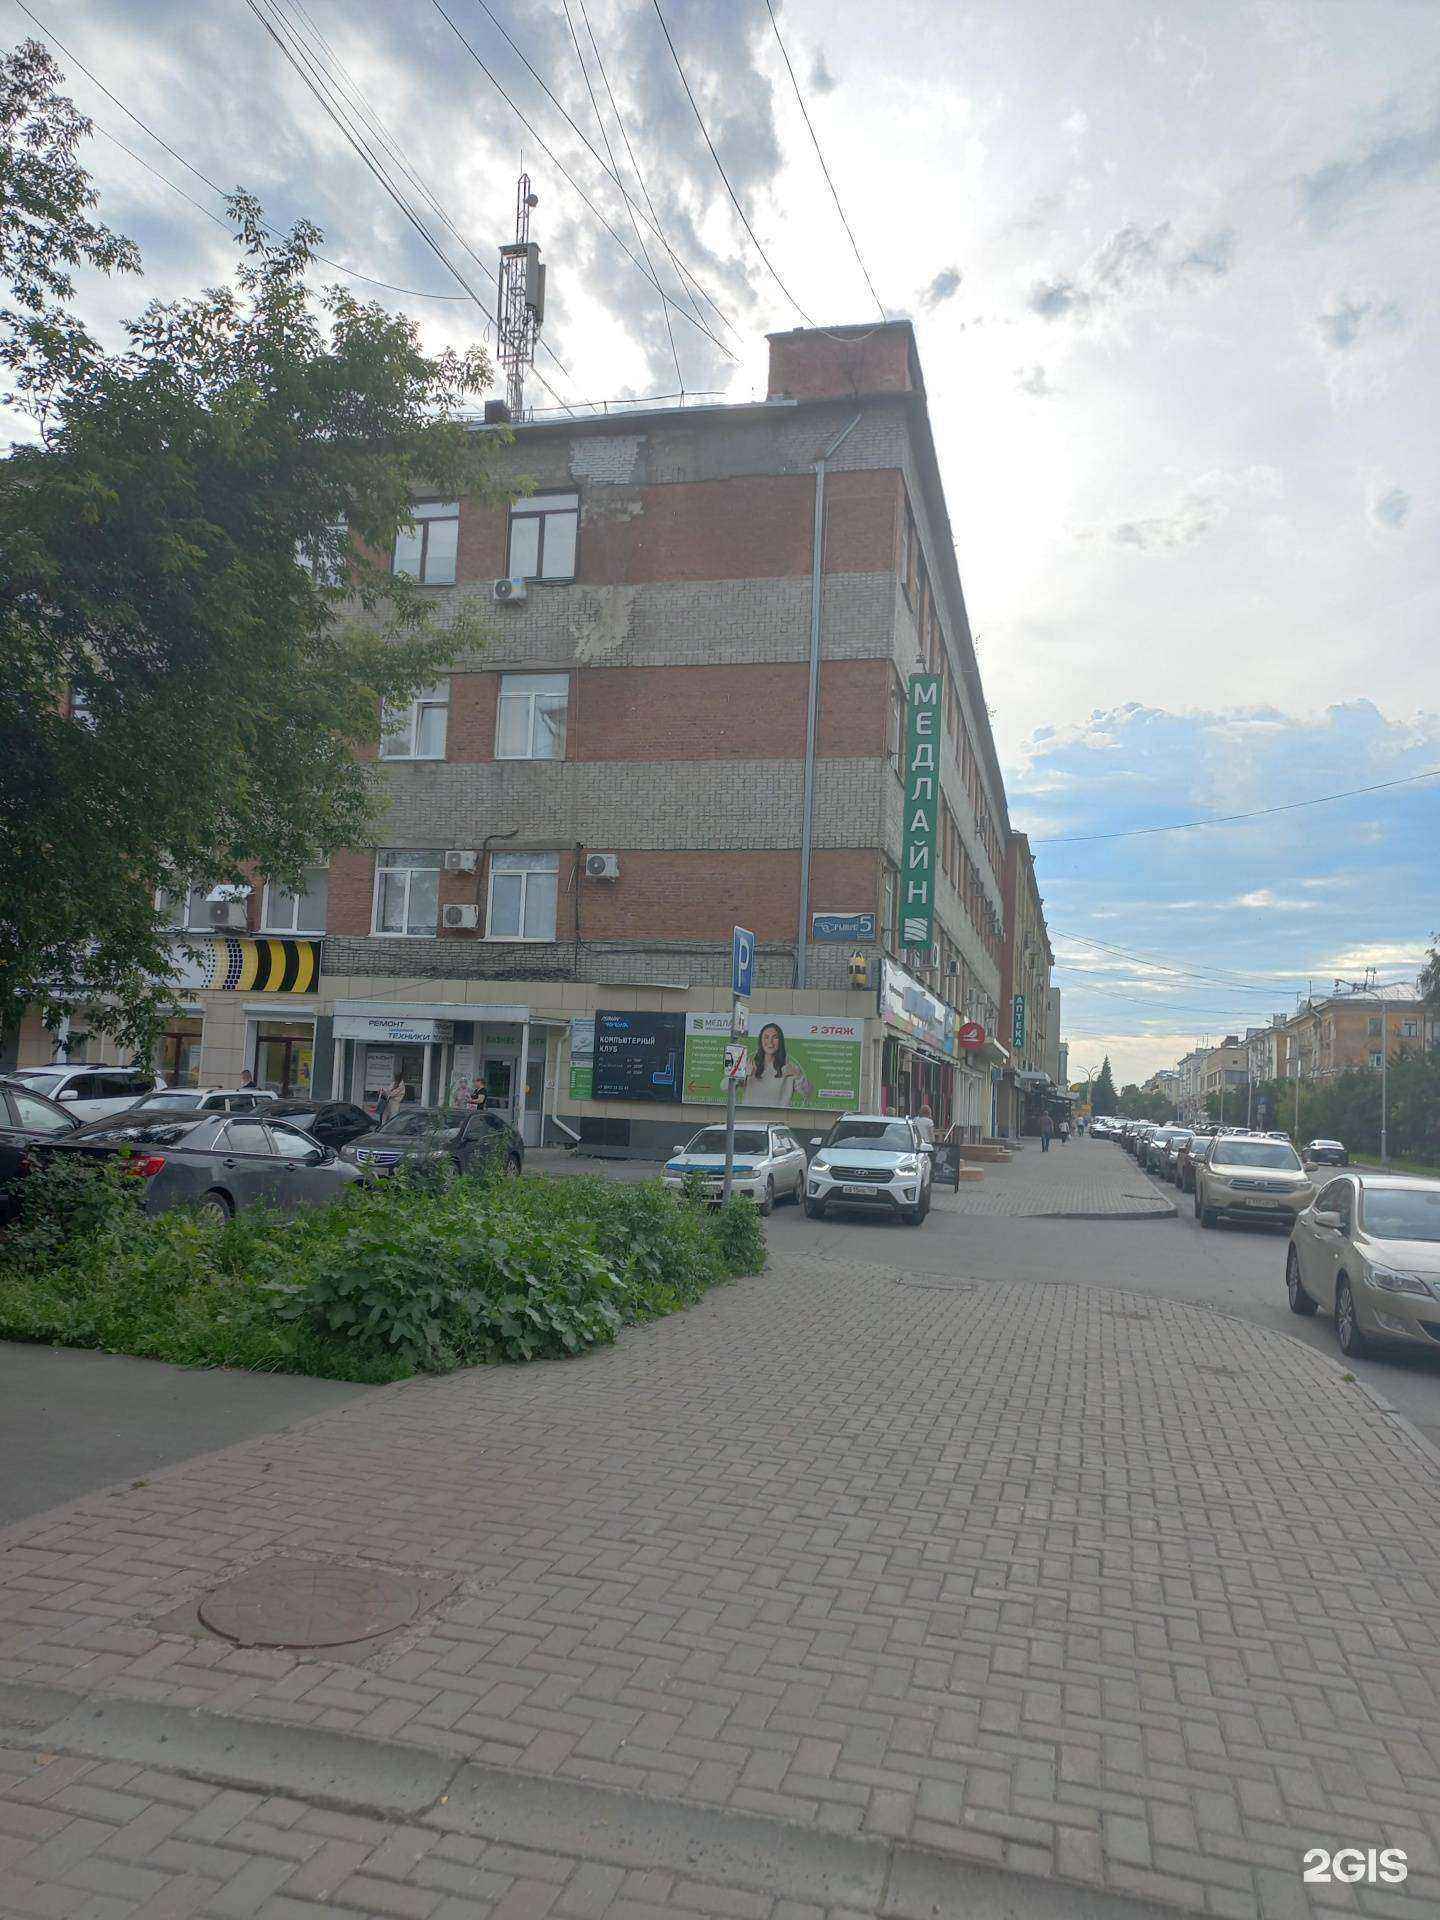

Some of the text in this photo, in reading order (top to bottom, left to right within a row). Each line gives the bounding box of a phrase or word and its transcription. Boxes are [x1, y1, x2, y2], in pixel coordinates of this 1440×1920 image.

[907, 682, 937, 904] МЕДЛАЙН
[859, 915, 872, 932] 5
[368, 1020, 405, 1028] РЕМОНТ
[1014, 995, 1024, 1047] АПТЕКА
[810, 1025, 855, 1035] 2 ЭТАЖ
[388, 1032, 431, 1041] ТЕХНИКИ
[600, 1035, 656, 1045] КОМПЬЮТЕРНЫЙ
[600, 1045, 618, 1053] КЛУБ
